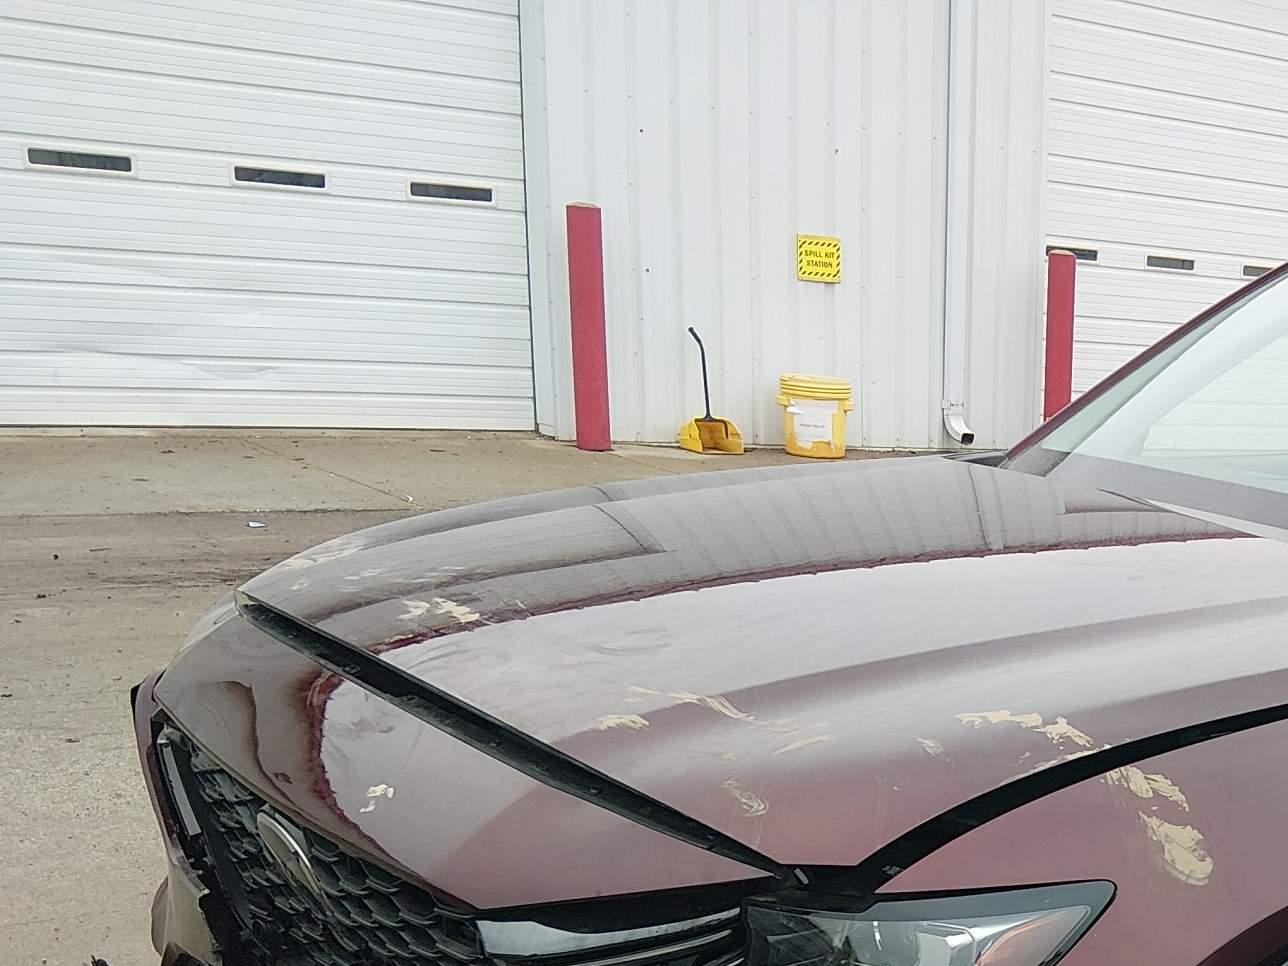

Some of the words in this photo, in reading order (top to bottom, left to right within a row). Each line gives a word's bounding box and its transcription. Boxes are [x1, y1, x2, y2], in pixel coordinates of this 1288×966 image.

[804, 249, 823, 258] SPILL
[824, 251, 836, 259] KIT
[806, 260, 833, 269] STATION
